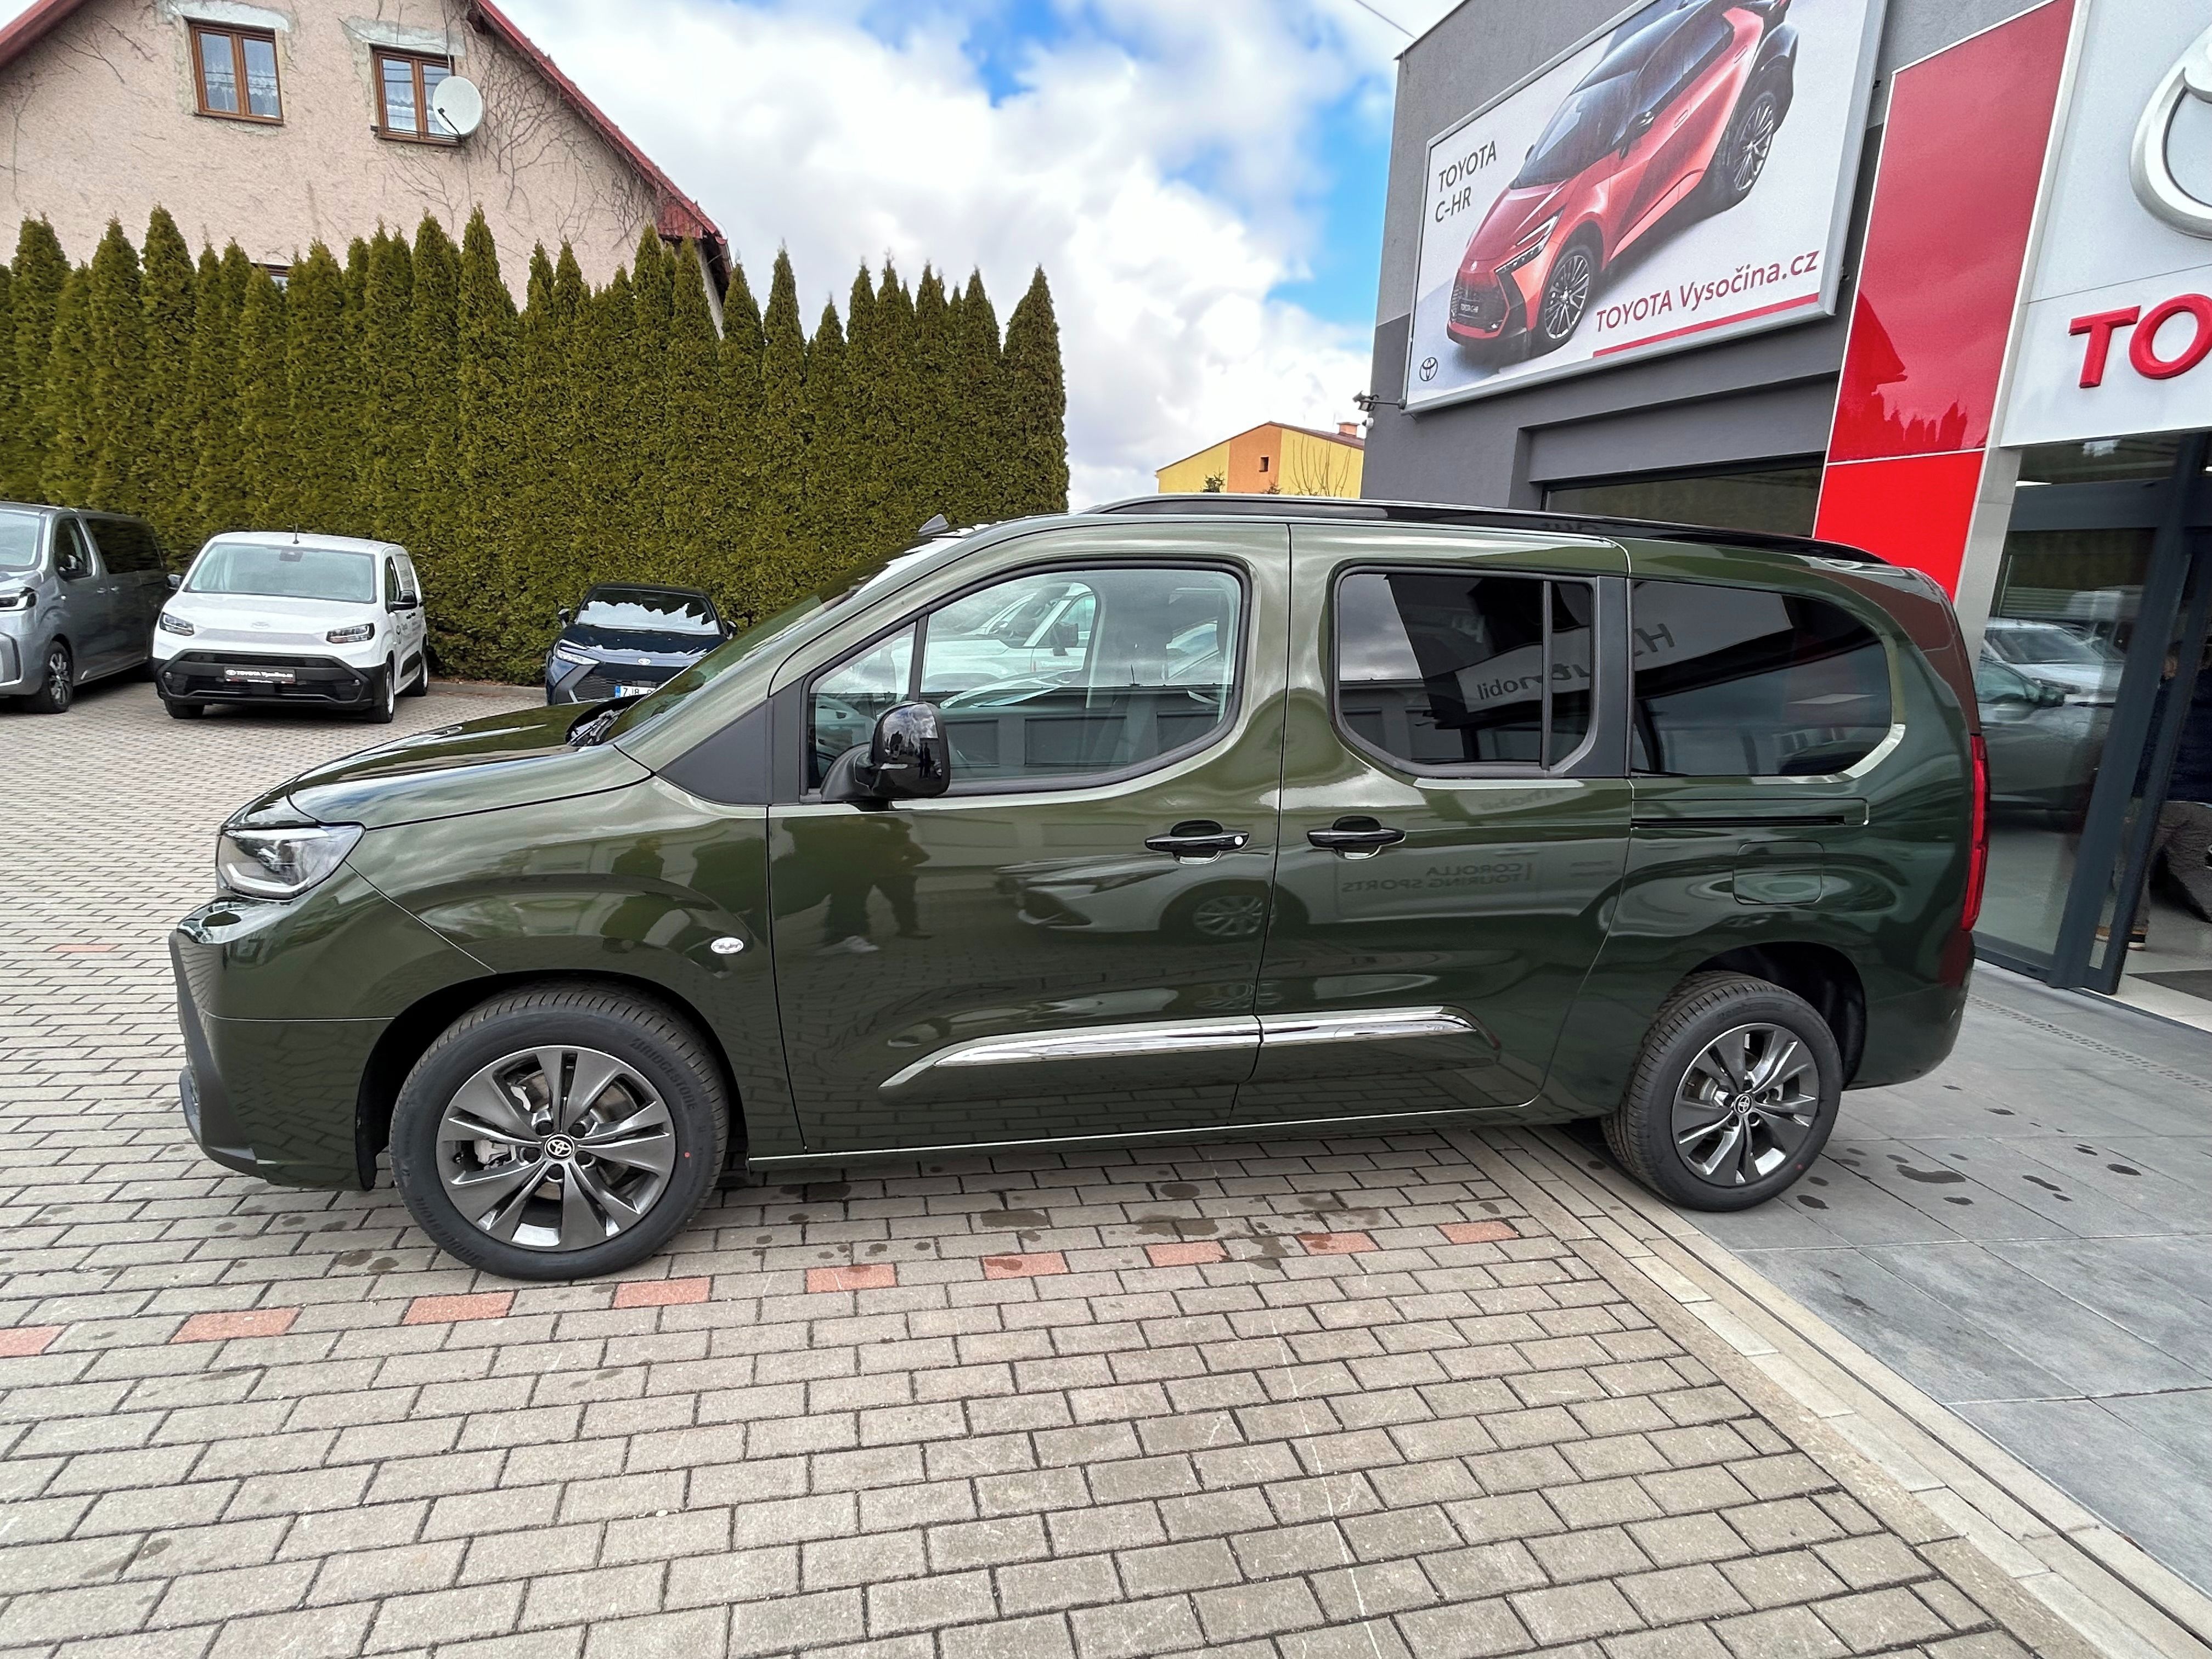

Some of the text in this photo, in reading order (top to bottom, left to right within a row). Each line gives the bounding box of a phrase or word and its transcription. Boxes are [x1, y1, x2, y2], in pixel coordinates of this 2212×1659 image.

[1438, 140, 1497, 193] TOYOTA
[1435, 185, 1471, 223] C-HR
[1596, 250, 1820, 332] TOYOTA Vysočina.cz
[629, 1036, 698, 1111] BRIDGESTONE
